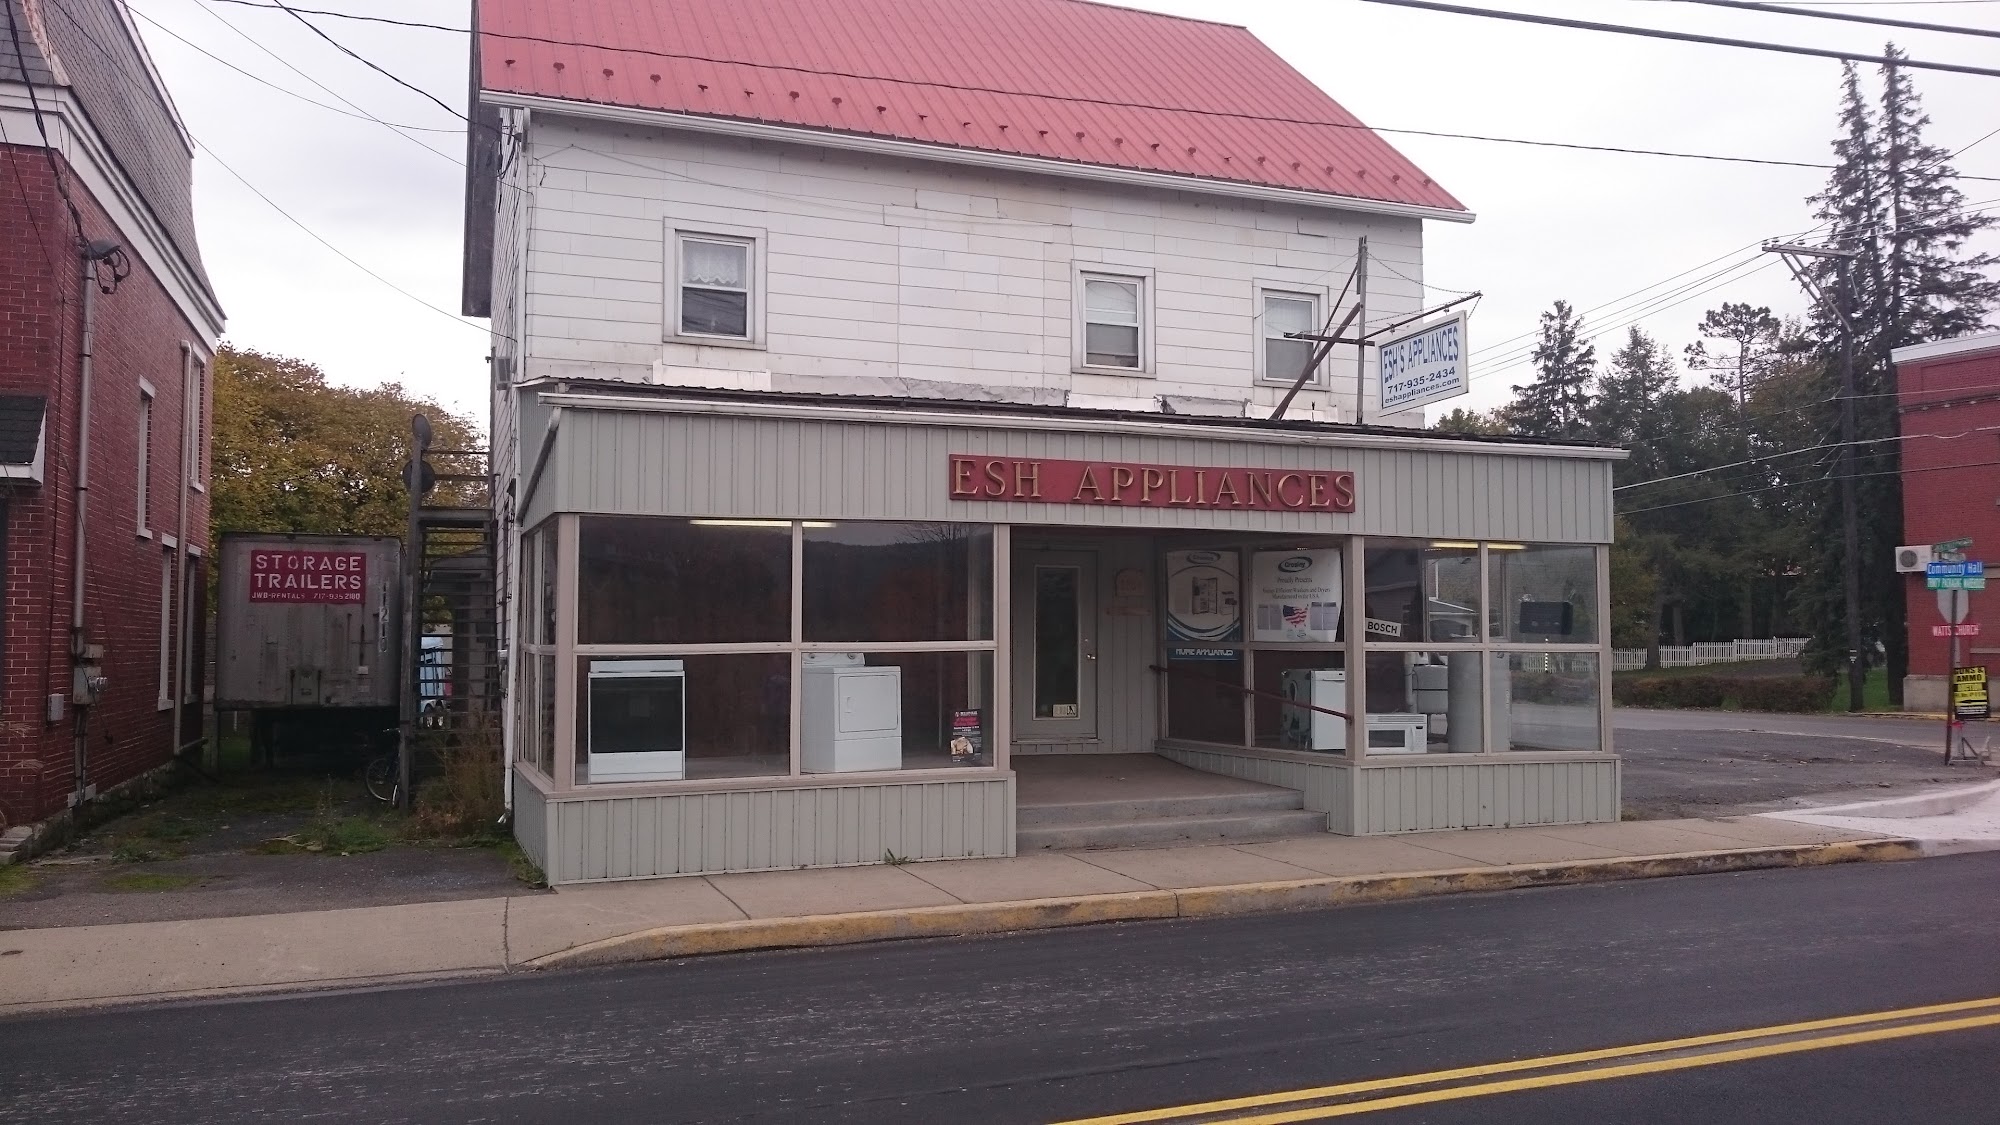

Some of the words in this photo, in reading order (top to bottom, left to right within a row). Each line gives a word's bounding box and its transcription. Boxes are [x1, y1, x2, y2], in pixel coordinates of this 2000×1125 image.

[1383, 344, 1405, 384] ESH'S
[1407, 325, 1459, 370] APPLIANCES
[1387, 366, 1456, 395] 717-935-2434
[1384, 377, 1460, 404] eshappliances.com
[952, 458, 1042, 498] ESH
[1072, 464, 1355, 508] APPLIANCES
[255, 554, 362, 571] STORAGE
[1283, 560, 1306, 569] Crosley
[1927, 563, 1966, 576] Community
[1967, 561, 1983, 573] Hall
[253, 573, 362, 590] TRAILERS
[1367, 620, 1398, 634] BOSCH
[1932, 625, 1951, 636] WATTS
[1956, 674, 1982, 682] AMMO
